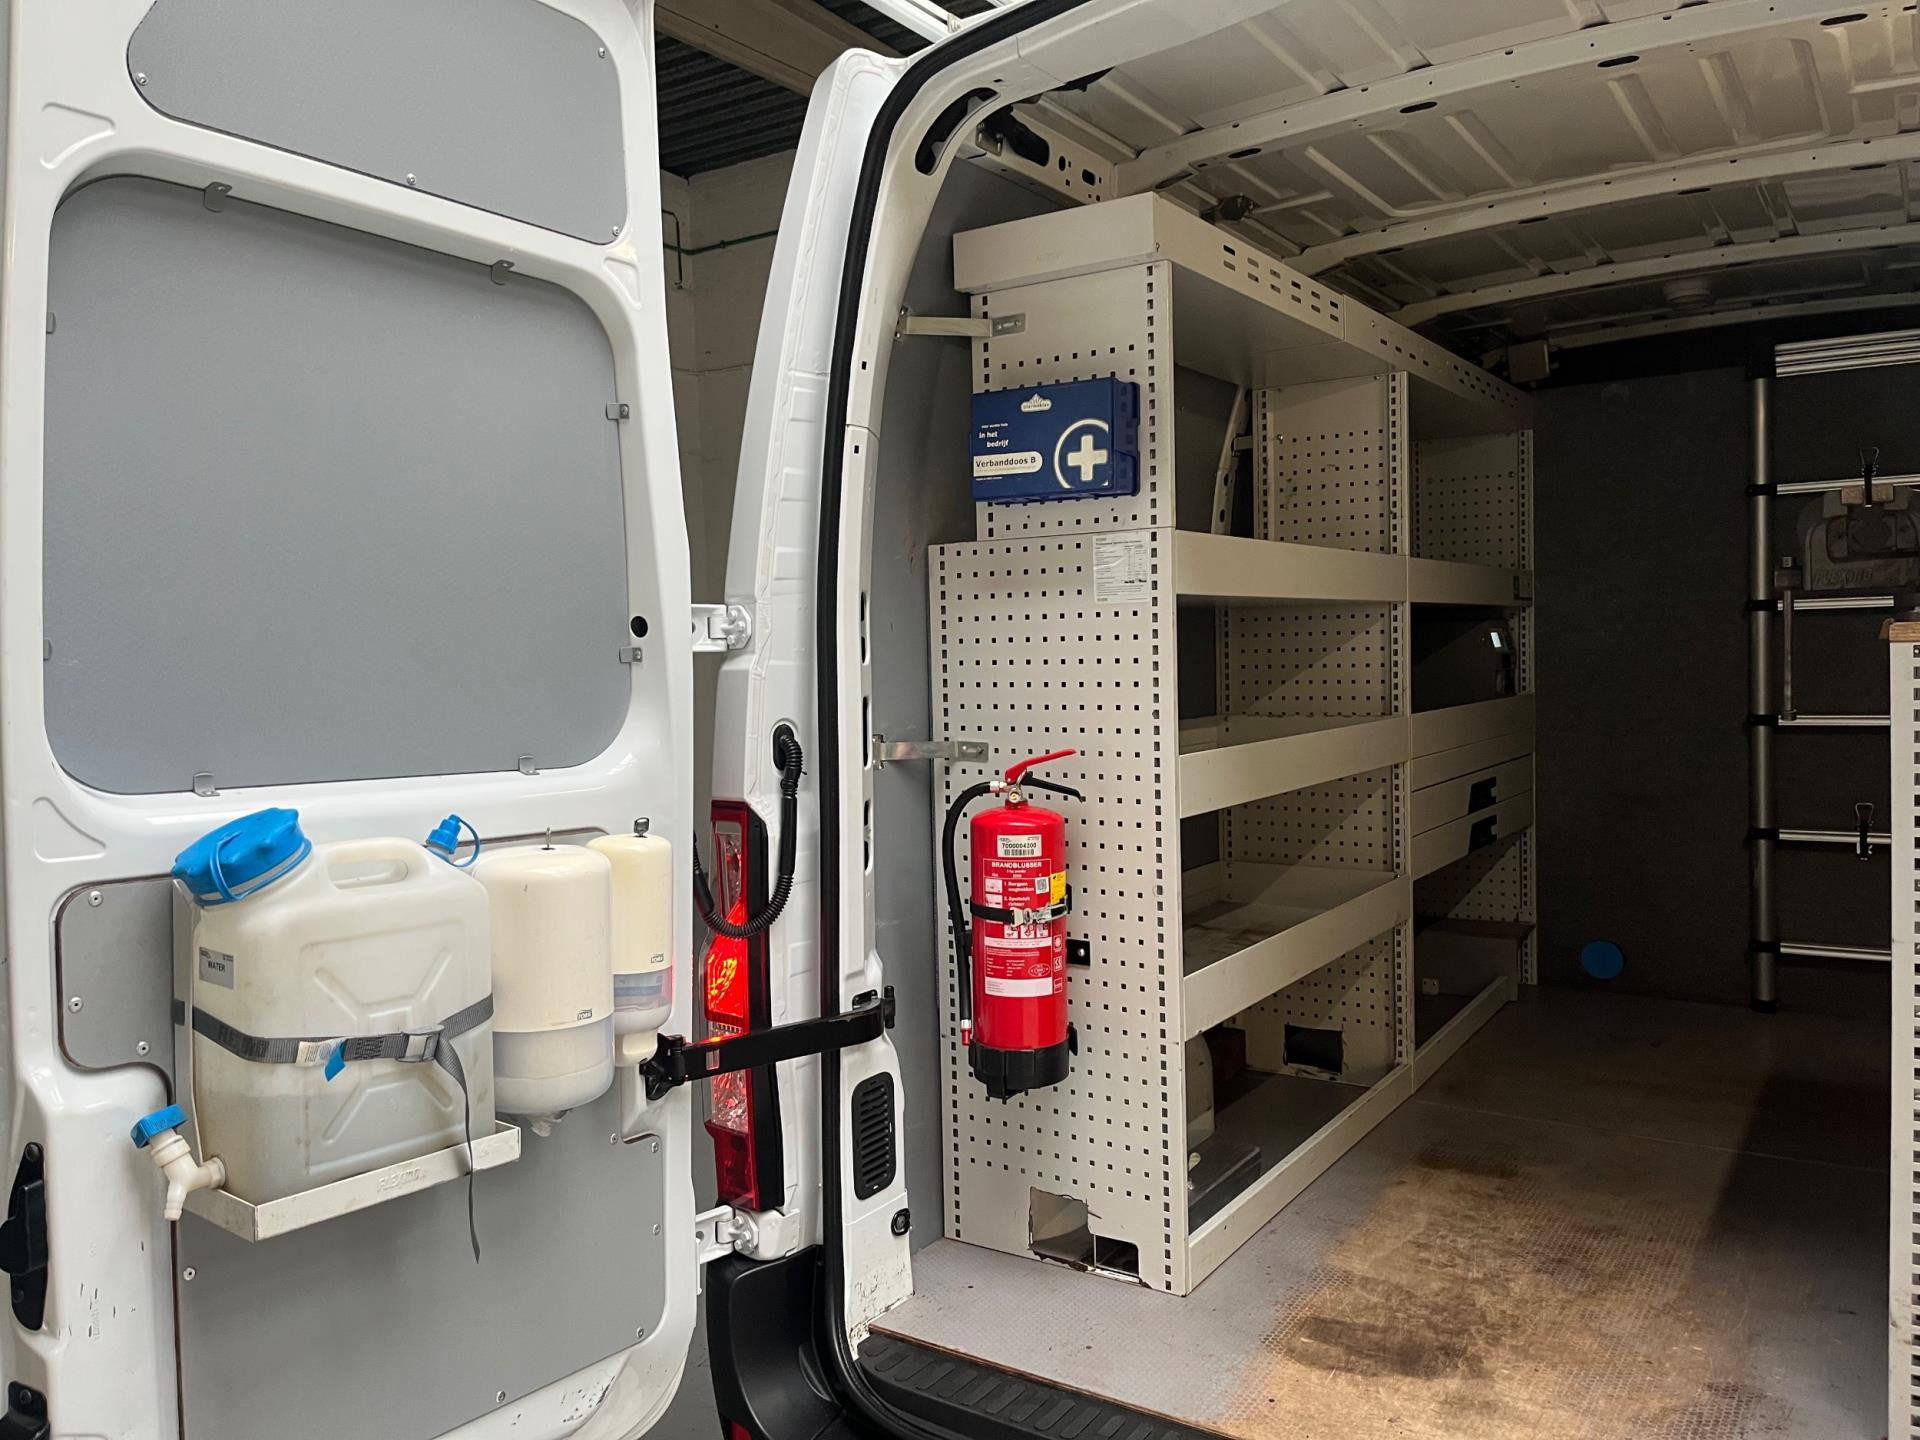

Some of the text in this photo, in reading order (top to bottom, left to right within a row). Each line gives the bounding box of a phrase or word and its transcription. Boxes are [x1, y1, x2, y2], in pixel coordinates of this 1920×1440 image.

[987, 430, 998, 438] het
[986, 439, 1009, 448] bedrijf
[976, 457, 1028, 468] Verbanddoos
[1030, 456, 1036, 464] B
[991, 861, 1042, 869] BRANDBLUSSER
[207, 960, 226, 973] WATER
